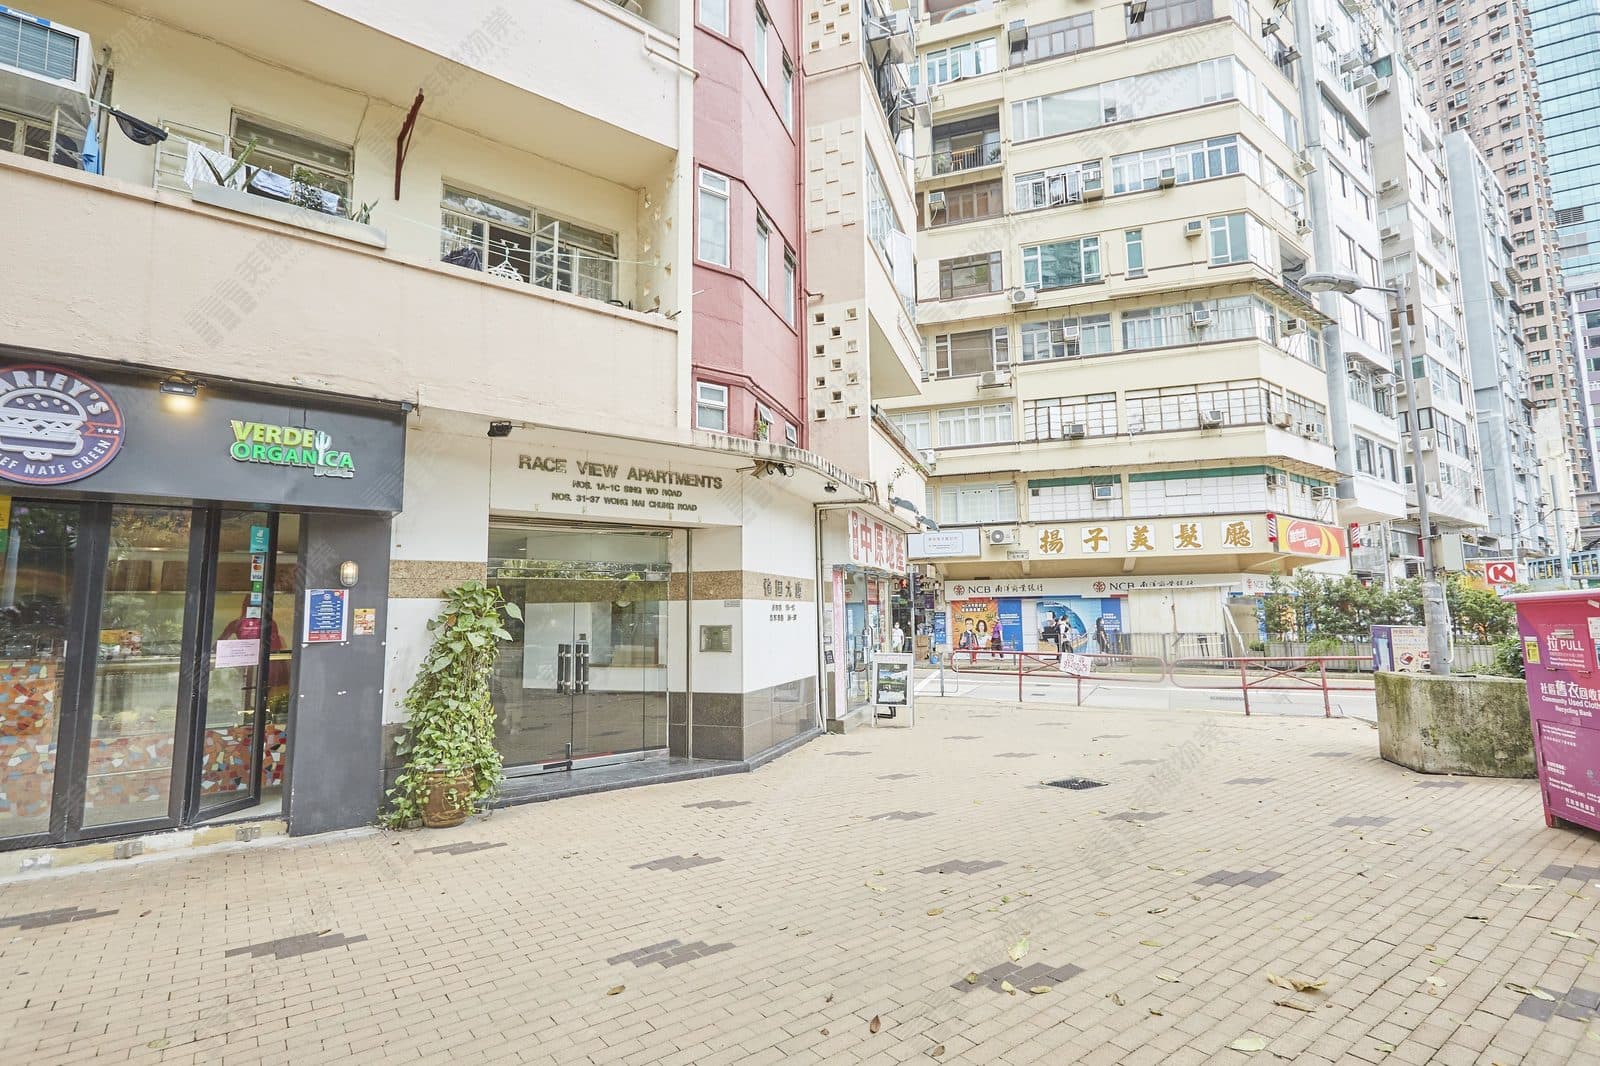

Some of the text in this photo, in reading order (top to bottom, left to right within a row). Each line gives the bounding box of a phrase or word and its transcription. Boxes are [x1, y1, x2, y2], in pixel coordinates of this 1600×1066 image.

[230, 419, 315, 448] VERDE
[24, 463, 67, 475] NATE
[71, 439, 112, 470] GREEN
[518, 454, 724, 490] RACE VIEW APARTMENTS
[596, 481, 620, 493] 1A-1C
[661, 488, 683, 498] ROAD
[551, 491, 572, 502] NOS.
[575, 493, 600, 504] 31-37
[603, 496, 629, 507] WONG
[677, 502, 698, 512] ROAD
[968, 584, 991, 594] NCB
[1109, 582, 1135, 591] NCB
[1547, 634, 1585, 652] 拉 PULL
[1540, 680, 1600, 701] 社區舊衣回收
[1568, 698, 1584, 708] Used
